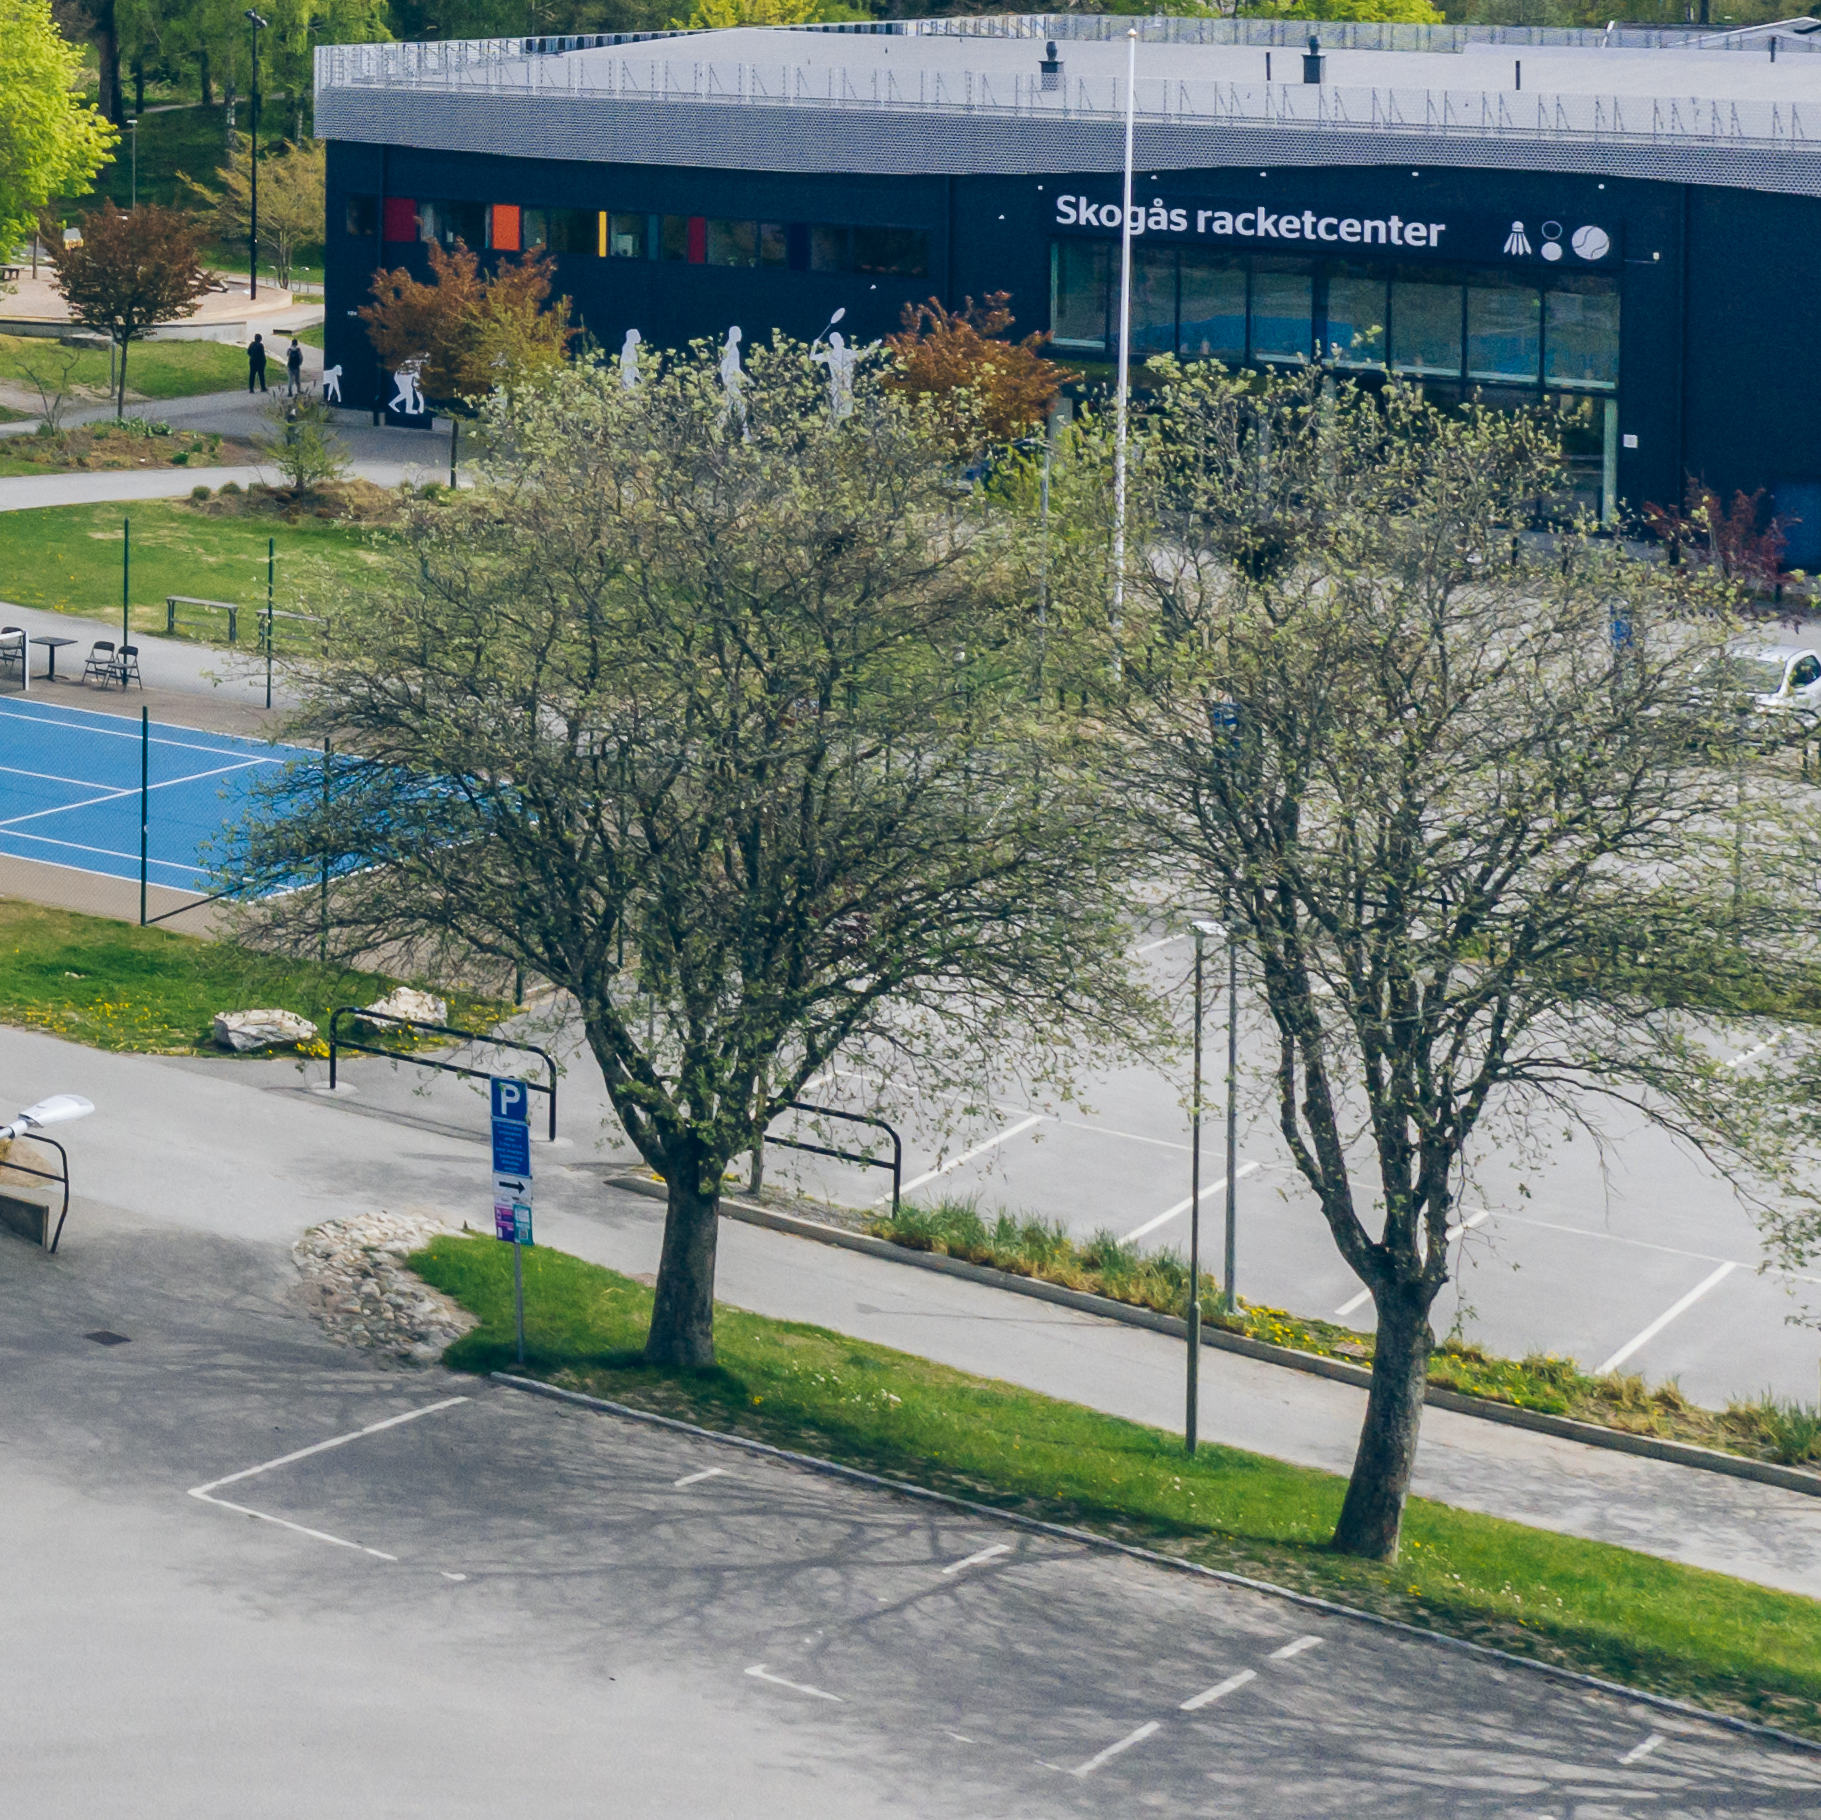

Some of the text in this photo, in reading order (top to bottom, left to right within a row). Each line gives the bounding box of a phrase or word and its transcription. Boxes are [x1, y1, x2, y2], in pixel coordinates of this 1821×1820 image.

[1056, 194, 1446, 247] Skogås racketcenter
[499, 1082, 521, 1116] P
